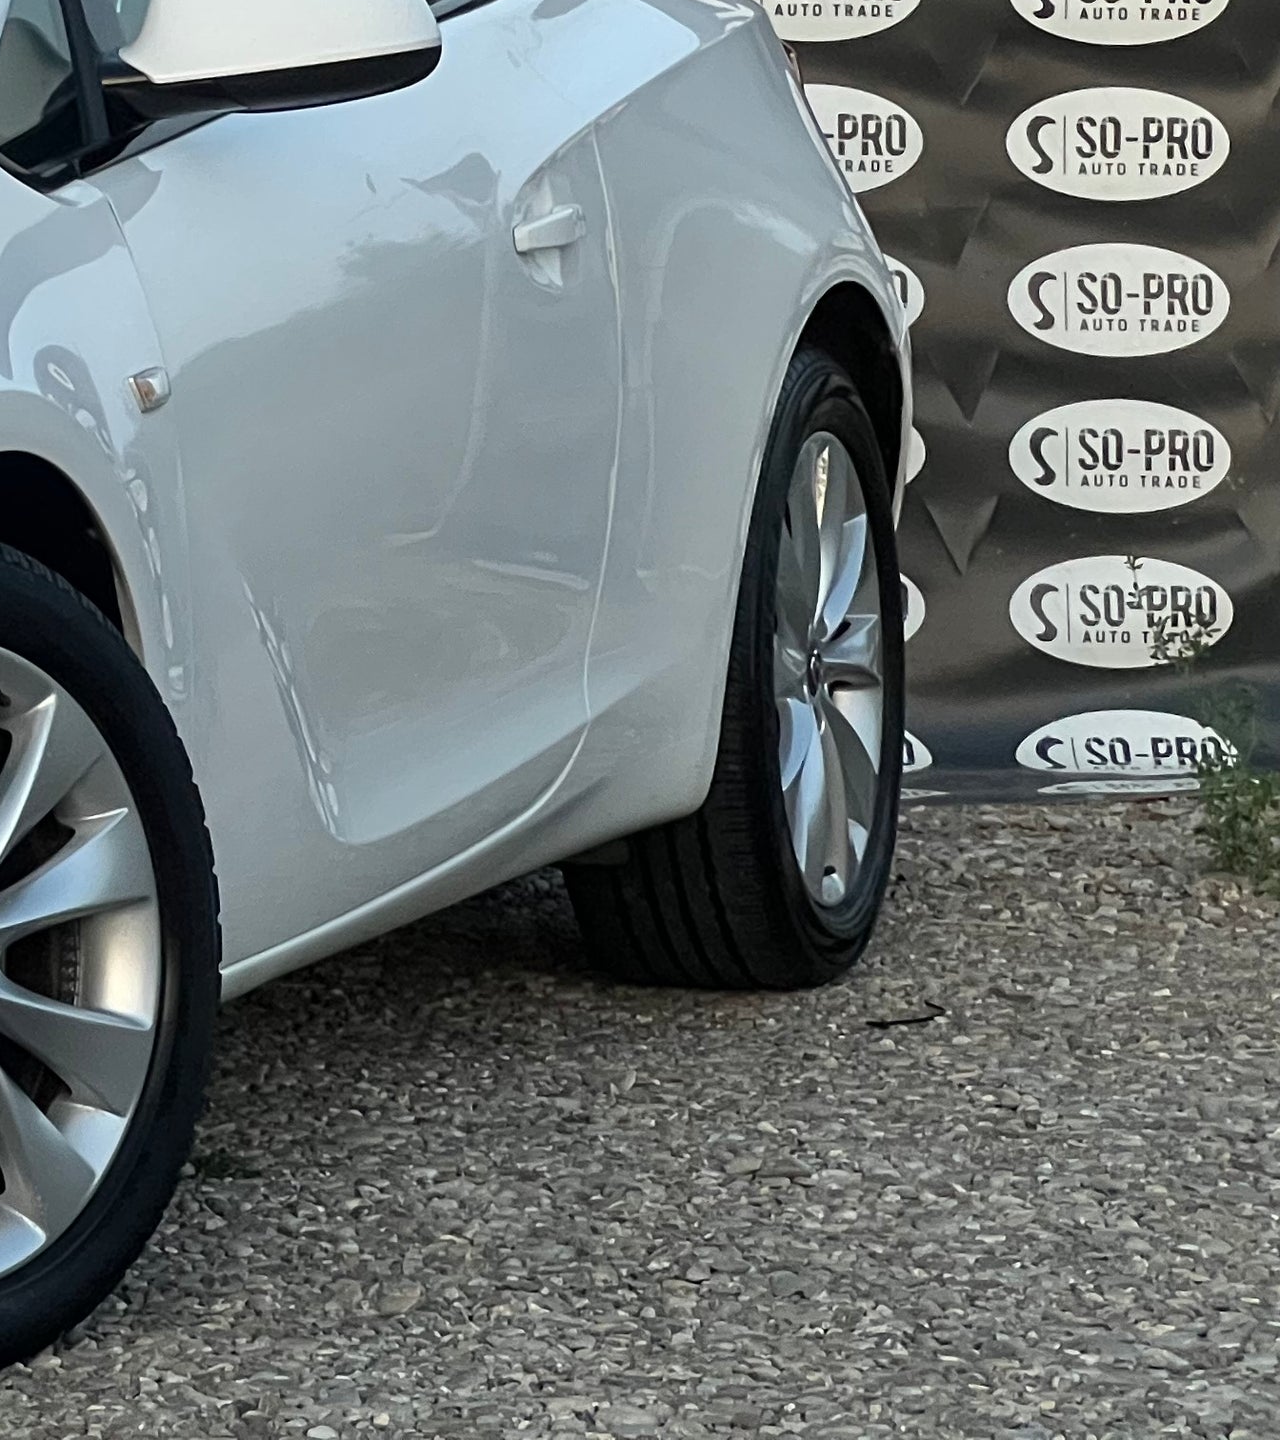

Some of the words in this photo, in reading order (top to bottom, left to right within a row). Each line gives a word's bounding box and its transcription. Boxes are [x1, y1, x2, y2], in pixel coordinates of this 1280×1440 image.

[775, 4, 822, 16] AUTO
[834, 4, 893, 17] TRADE
[1080, 8, 1127, 20] AUTO
[1140, 8, 1199, 20] TRADE
[824, 114, 907, 156] -PRO
[1075, 117, 1213, 160] SO-PRO
[844, 160, 893, 172] RADE
[1079, 163, 1126, 175] AUTO
[1139, 163, 1198, 176] TRADE
[1076, 272, 1214, 315] SO-PRO
[1080, 319, 1127, 331] AUTO
[1140, 319, 1199, 332] TRADE
[1078, 429, 1215, 471] SO-PRO
[1081, 474, 1128, 487] AUTO
[1141, 475, 1200, 488] TRADE
